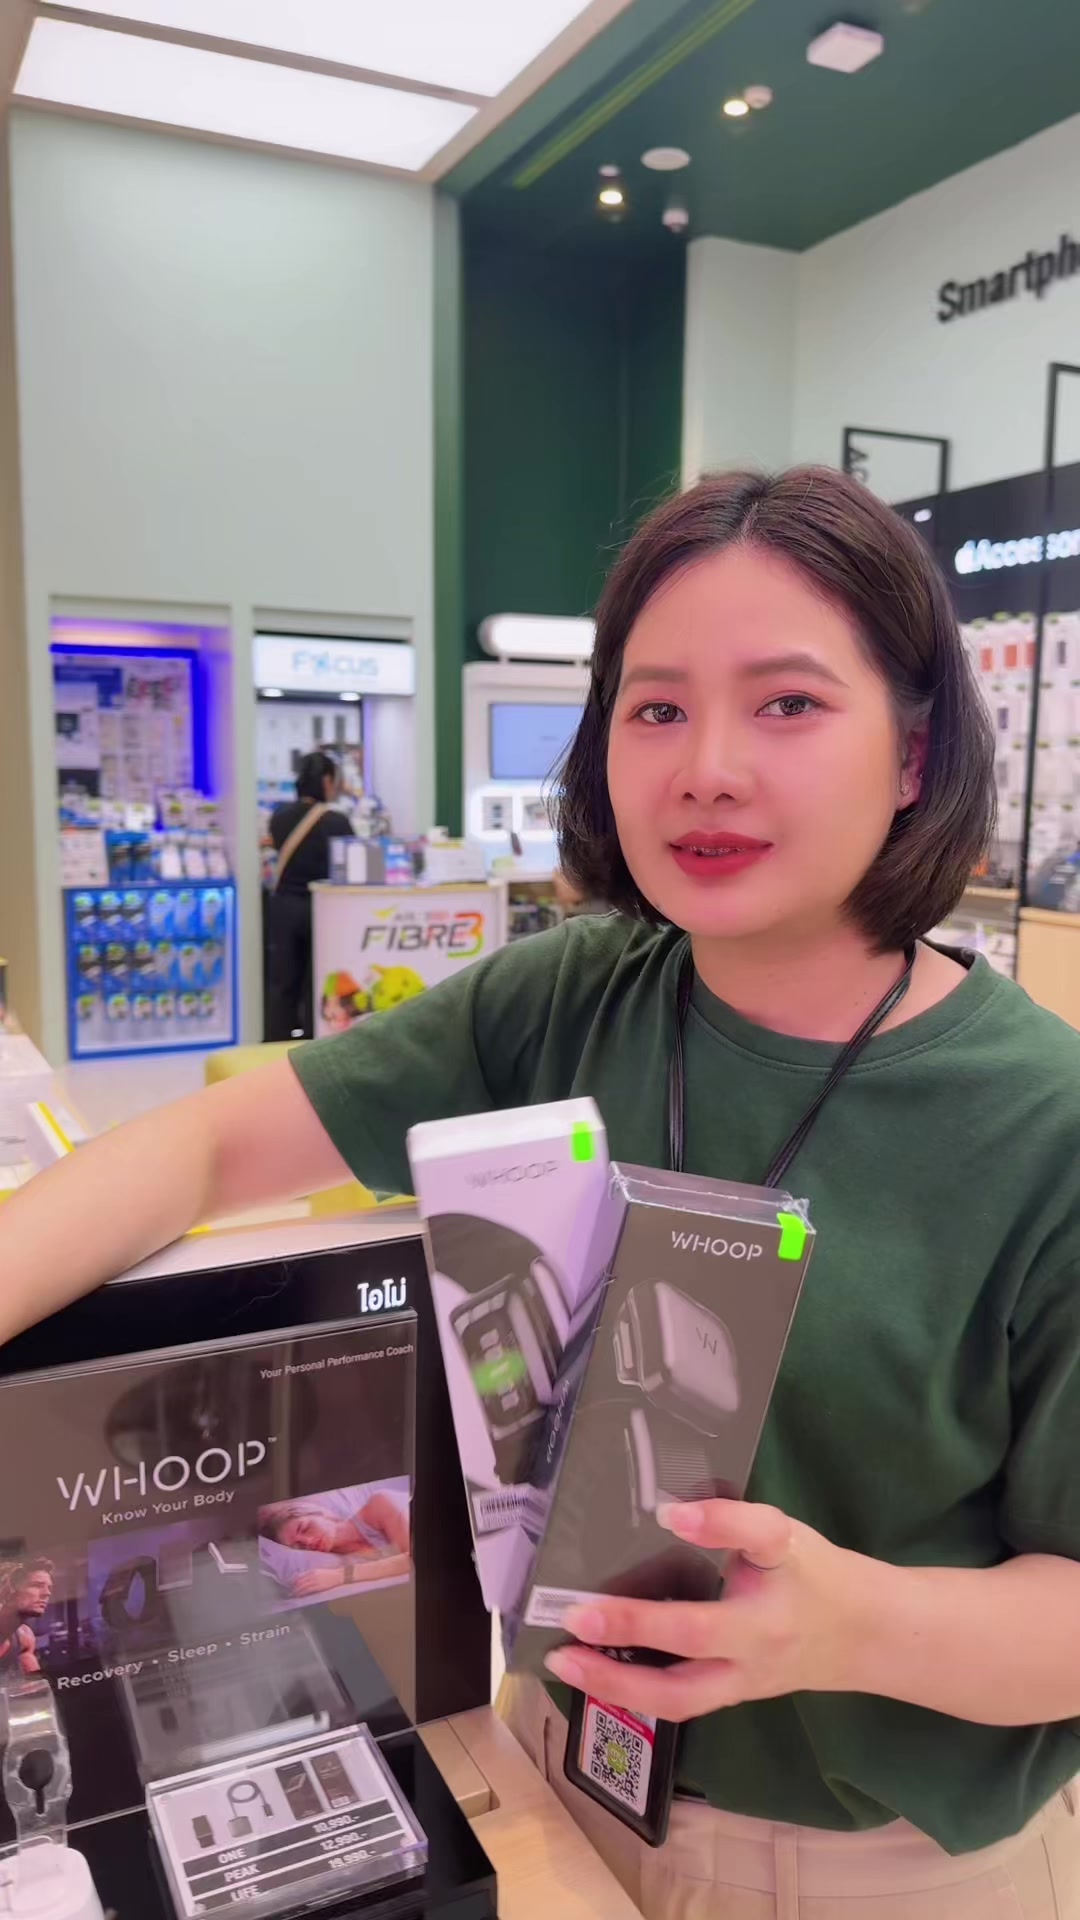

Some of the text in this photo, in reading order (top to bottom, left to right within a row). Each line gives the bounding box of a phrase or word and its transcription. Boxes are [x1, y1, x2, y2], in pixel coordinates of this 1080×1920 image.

[937, 232, 1080, 324] Smartph
[671, 1230, 763, 1261] WHOOP
[260, 1343, 414, 1380] Your Personal Performance Coach
[102, 1489, 236, 1525] Know Your Body
[57, 1660, 143, 1690] Recovery
[167, 1641, 218, 1663] Sleep
[240, 1623, 291, 1646] Strain
[218, 1848, 247, 1865] ONE
[224, 1864, 261, 1883] PEAK
[230, 1884, 261, 1903] LIFE
